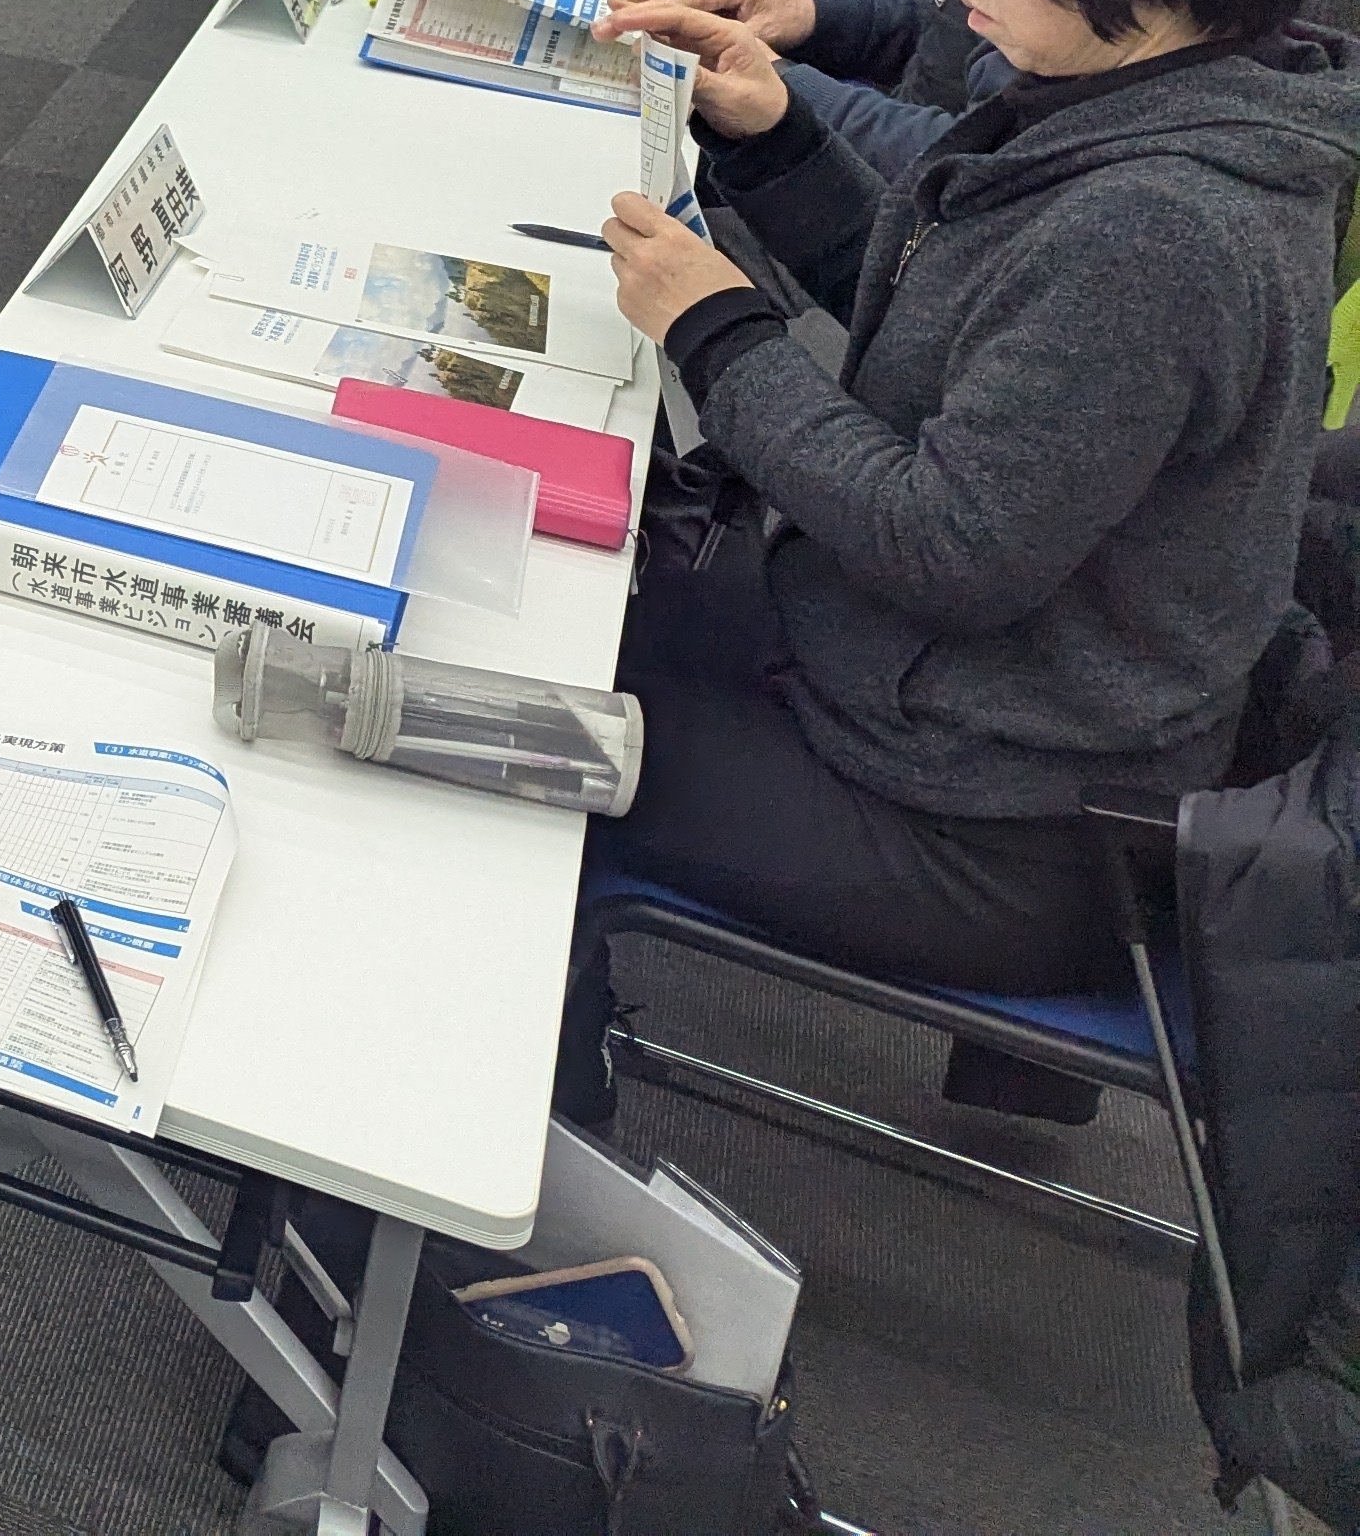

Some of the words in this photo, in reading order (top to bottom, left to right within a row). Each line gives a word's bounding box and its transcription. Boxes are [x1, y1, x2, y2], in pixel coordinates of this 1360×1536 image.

[11, 570, 242, 646] （水道事業ビジョン
